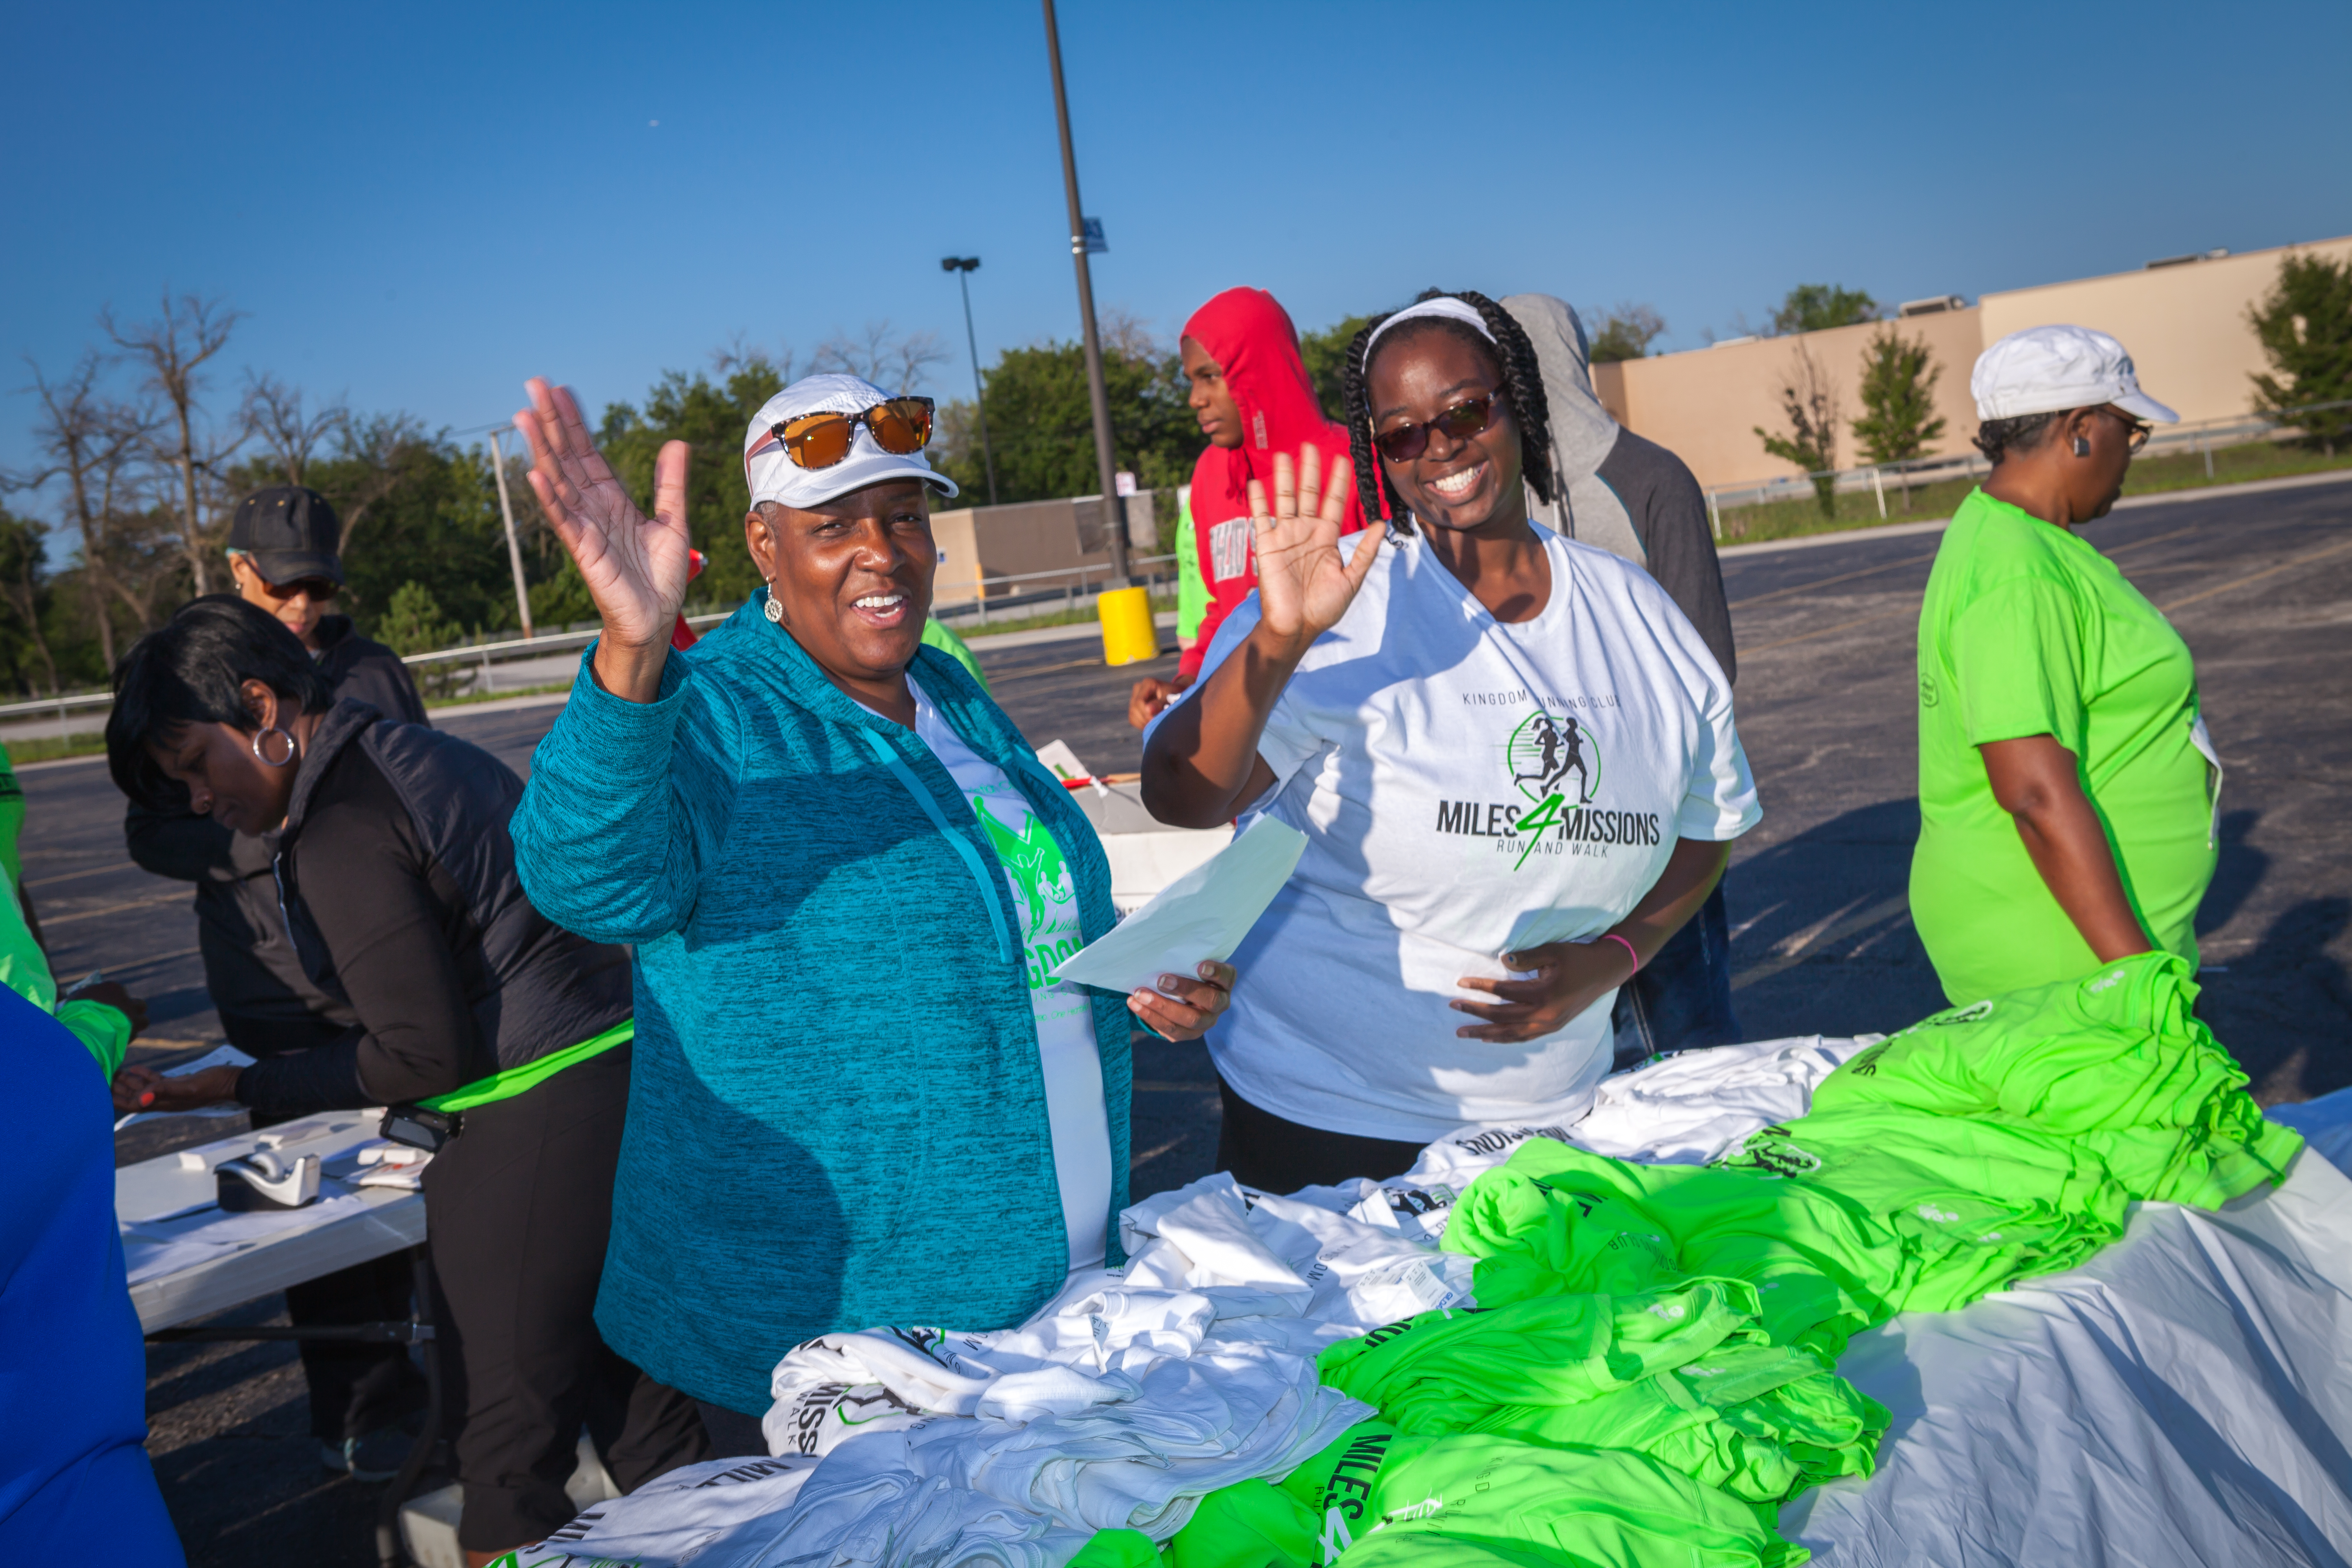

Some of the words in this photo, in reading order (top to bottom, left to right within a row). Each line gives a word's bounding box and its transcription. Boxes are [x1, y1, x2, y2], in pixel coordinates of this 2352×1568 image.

[1462, 689, 1527, 705] KINGDOM
[1537, 696, 1587, 709] UNNING
[1436, 799, 1521, 838] MILES
[1558, 808, 1660, 846] MISSIONS
[1497, 839, 1524, 853] RUN
[1534, 841, 1563, 855] AND
[1572, 841, 1608, 858] WALK
[1323, 1434, 1393, 1520] MILES
[1313, 1486, 1325, 1516] RU
